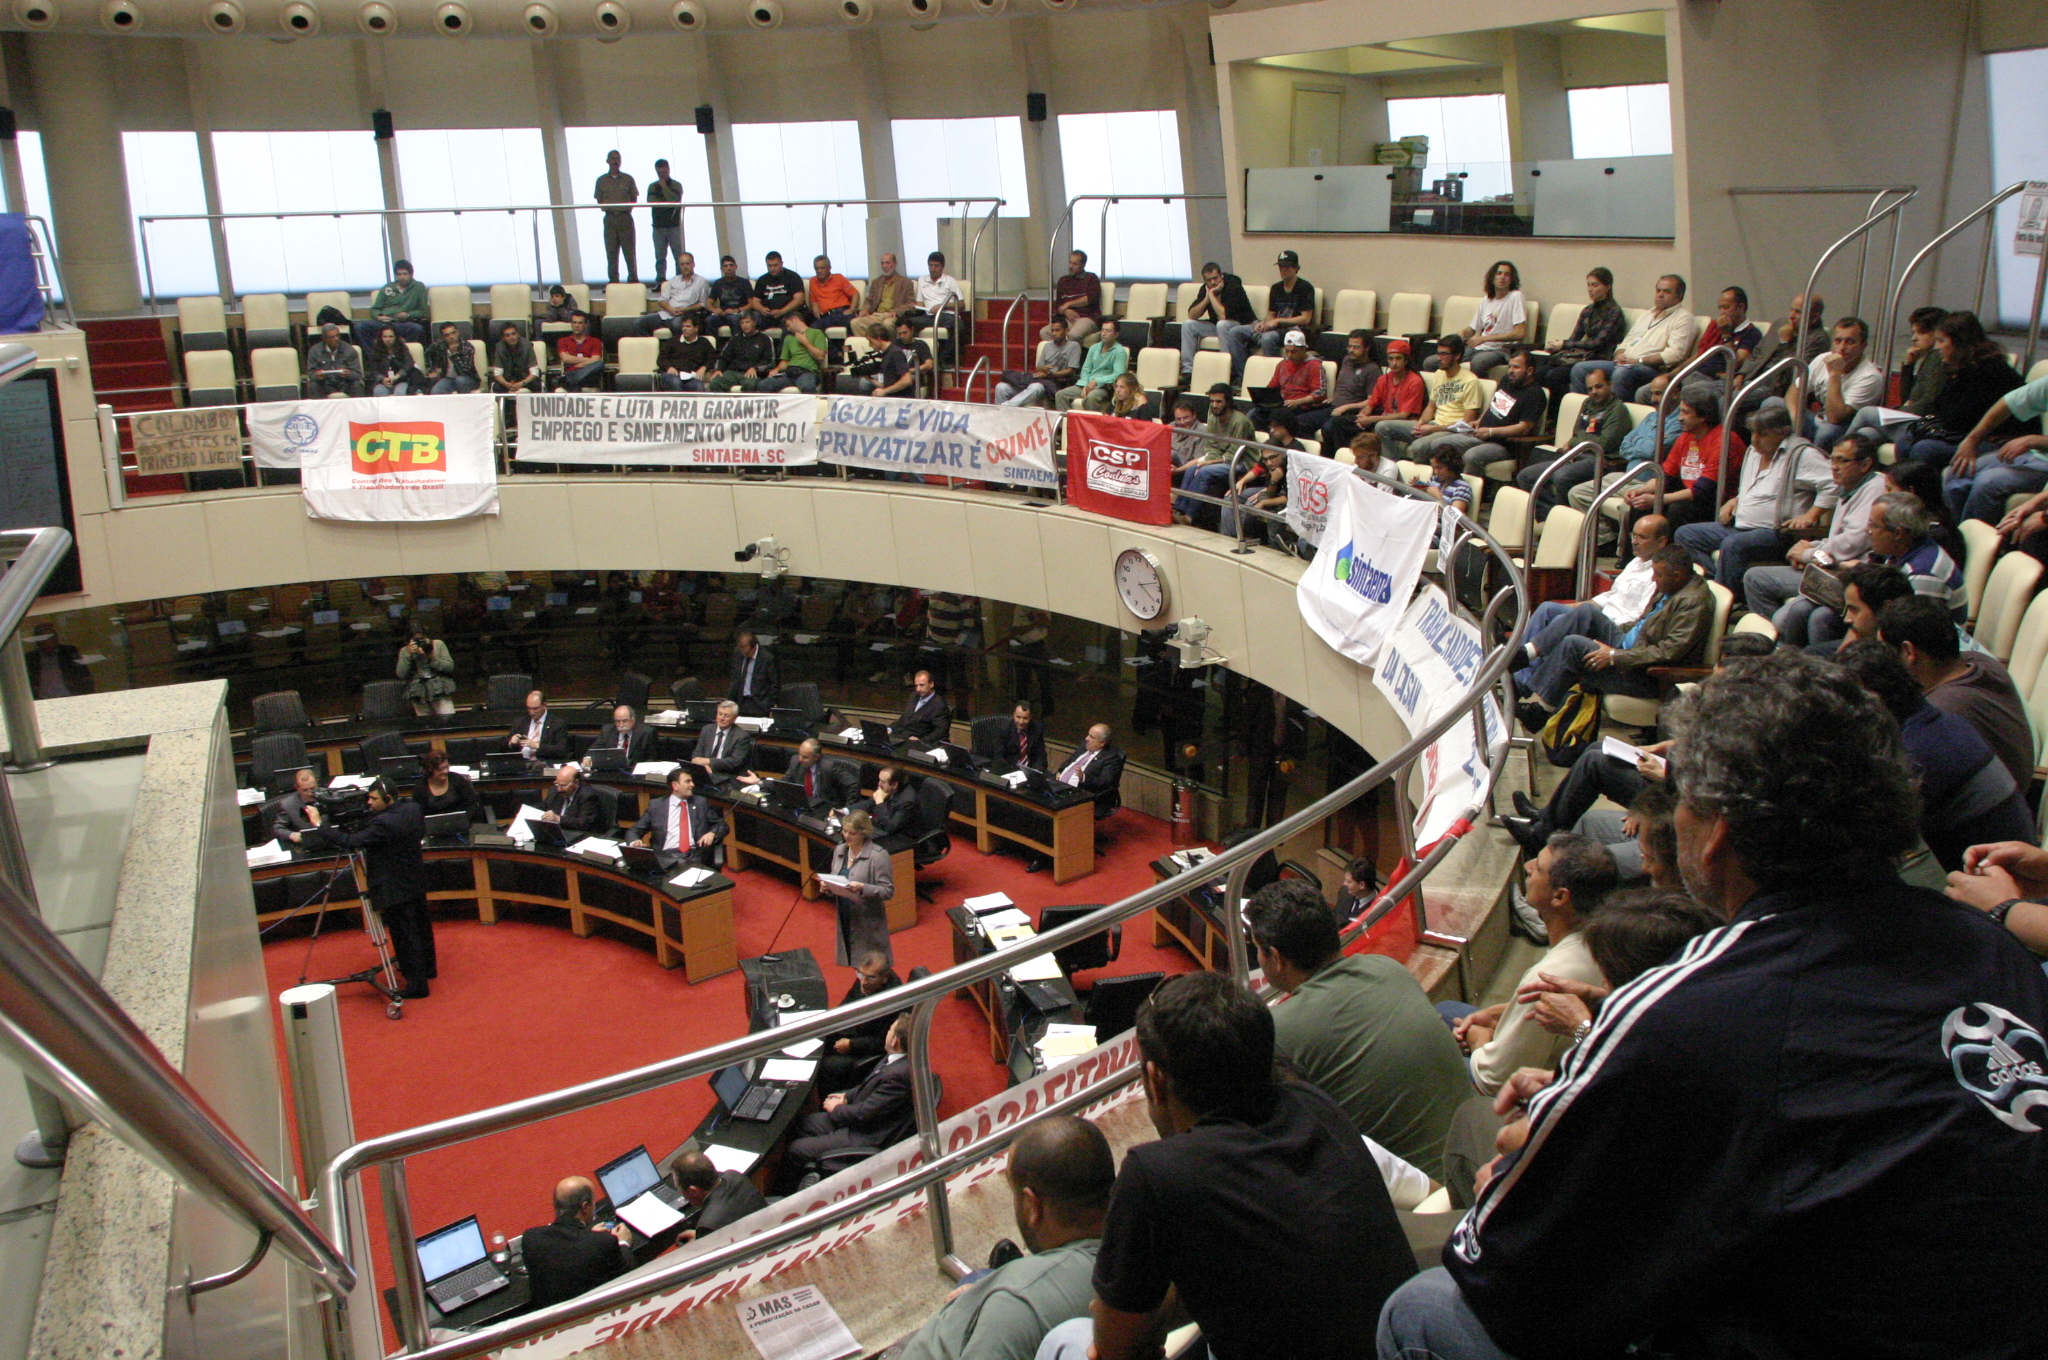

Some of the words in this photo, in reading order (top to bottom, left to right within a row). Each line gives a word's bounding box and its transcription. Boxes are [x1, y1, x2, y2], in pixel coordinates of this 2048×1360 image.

[530, 397, 596, 418] UNIDADE
[600, 398, 612, 418] E
[616, 399, 654, 419] LUTA
[660, 400, 698, 420] PARA
[703, 399, 780, 420] GARANTIR
[823, 397, 887, 428] ÁGUA
[895, 403, 912, 430] É
[918, 408, 970, 434] VIDA
[531, 421, 603, 442] EMPREGO
[608, 421, 618, 442] E
[623, 422, 725, 443] SANEAMENTO
[356, 430, 440, 464] CTB
[818, 430, 964, 469] PRIVATIZAR
[970, 440, 982, 469] É
[1093, 445, 1141, 466] CSP
[757, 1296, 793, 1317] MAS
